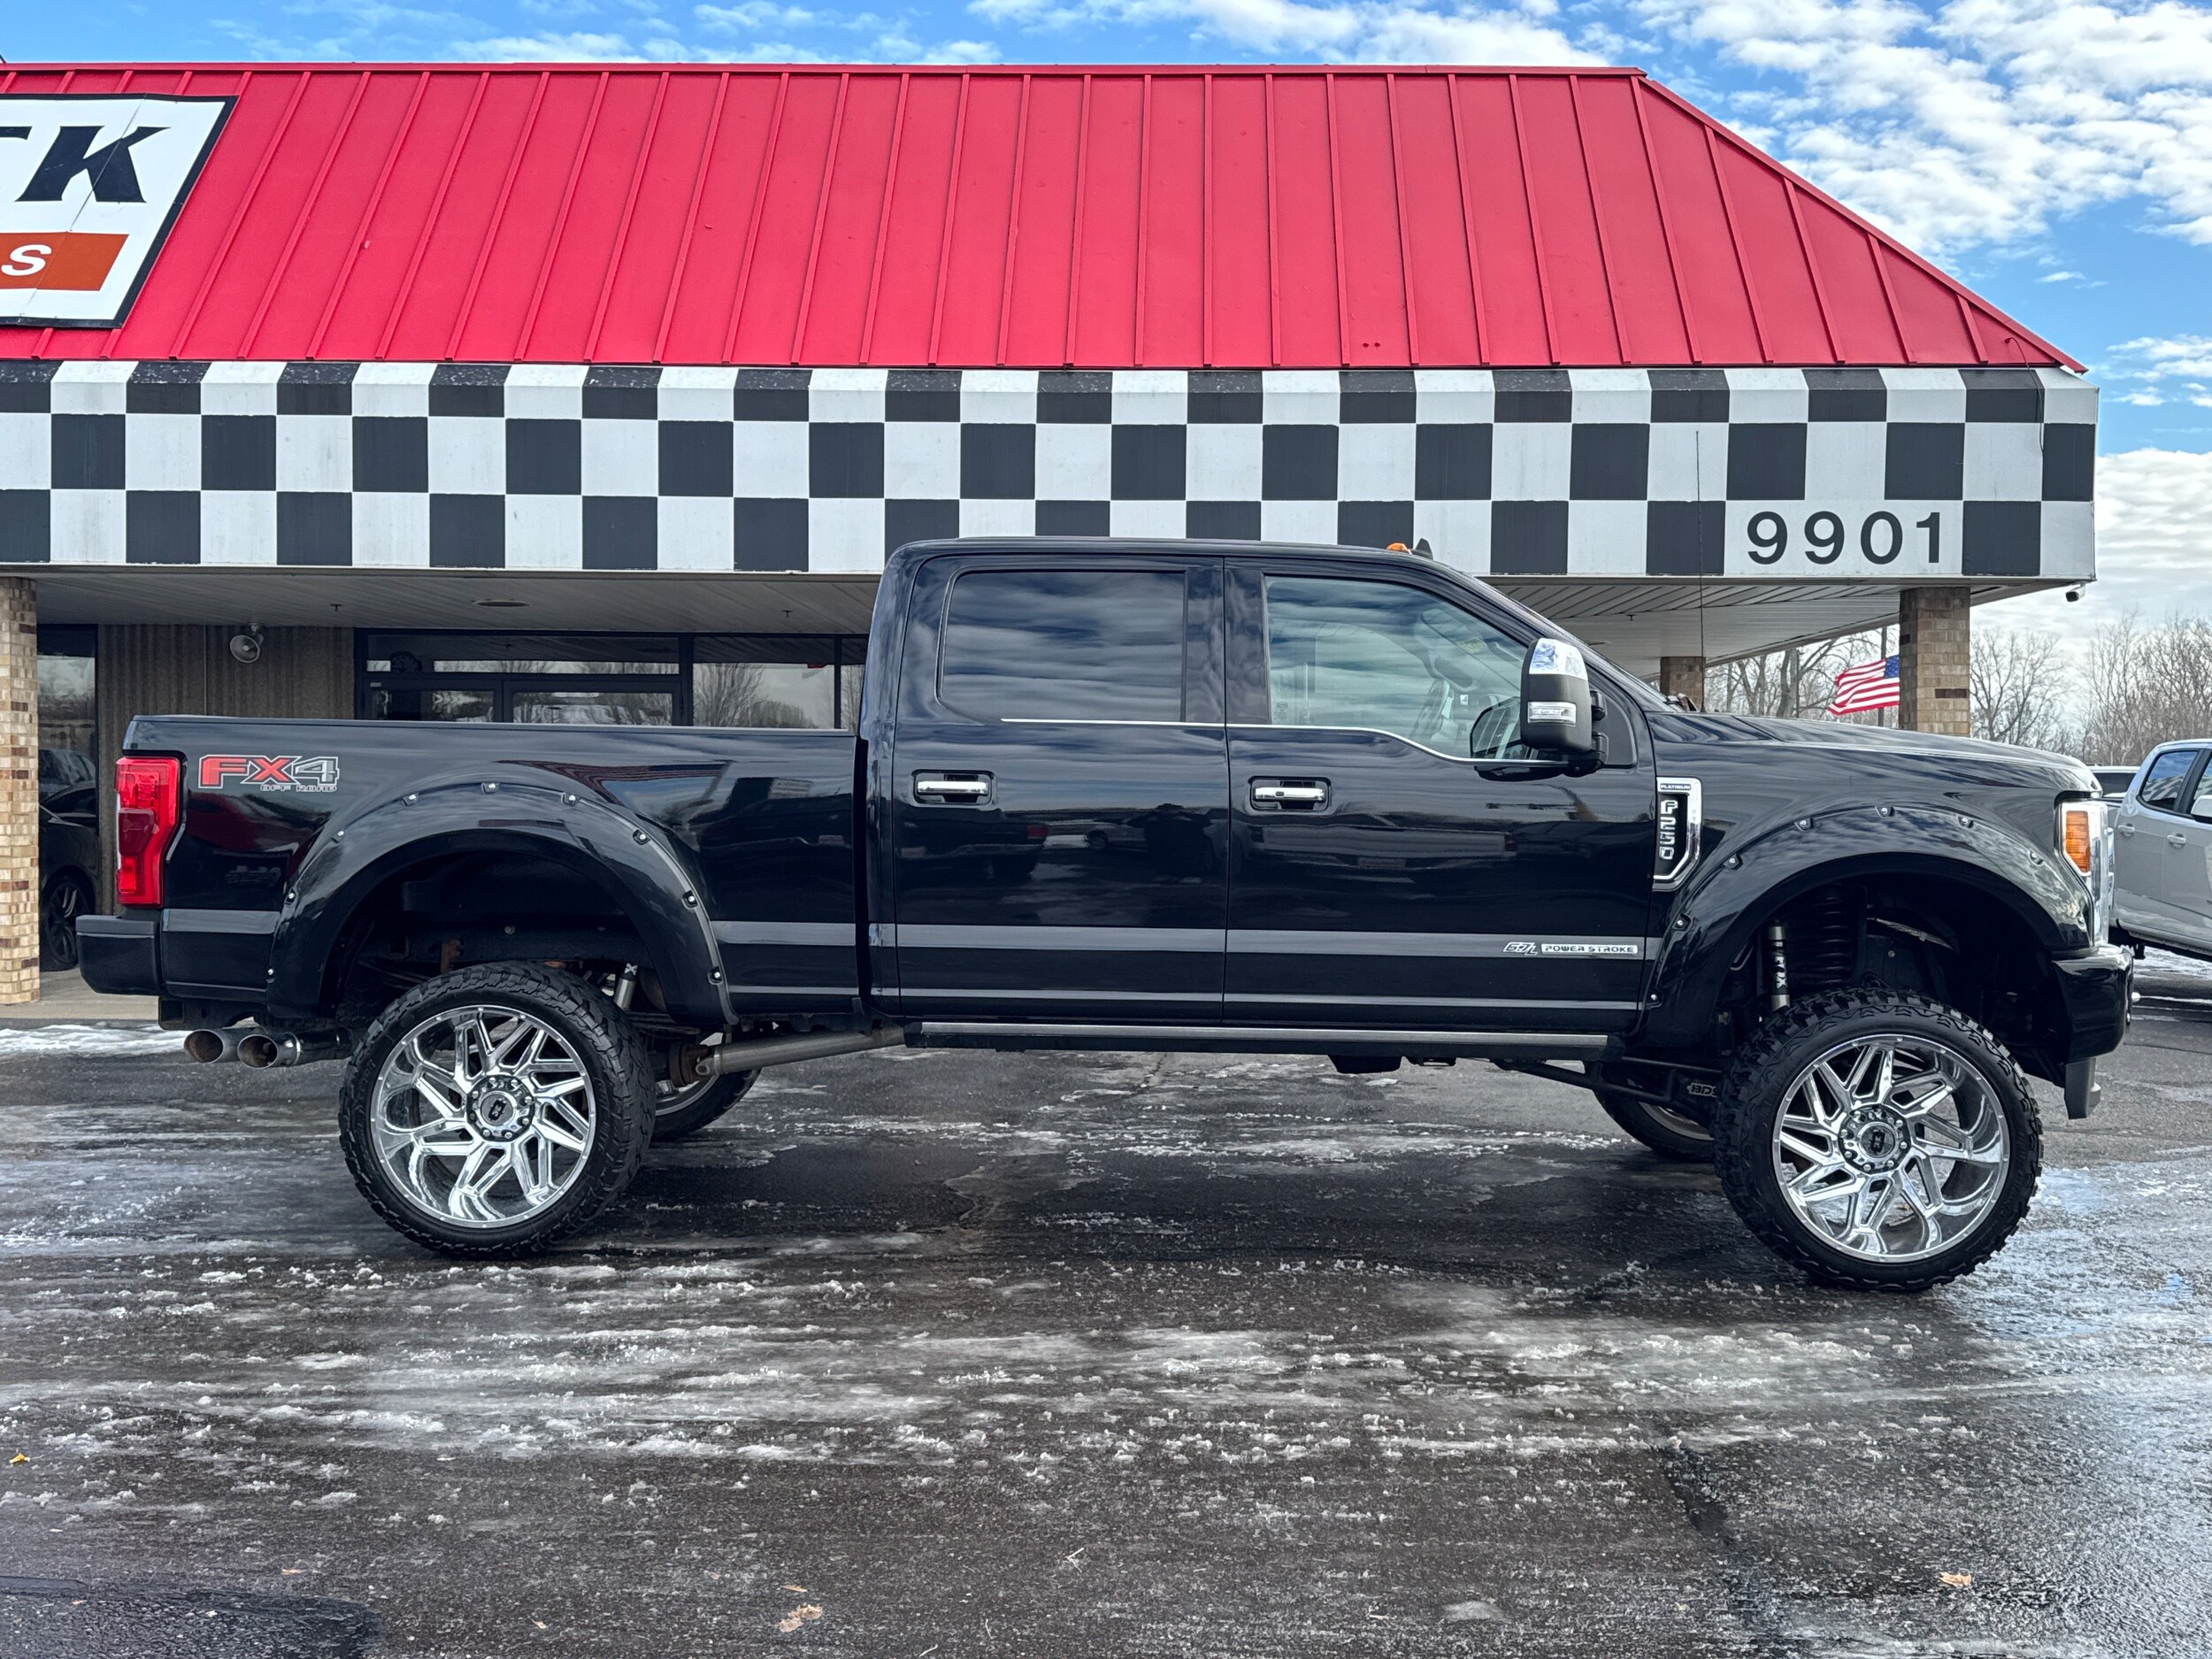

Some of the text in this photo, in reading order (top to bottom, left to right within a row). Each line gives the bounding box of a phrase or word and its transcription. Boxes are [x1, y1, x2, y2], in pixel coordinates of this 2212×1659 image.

[1, 244, 52, 276] S
[1747, 511, 1940, 565] 9901
[198, 755, 340, 788] FX4
